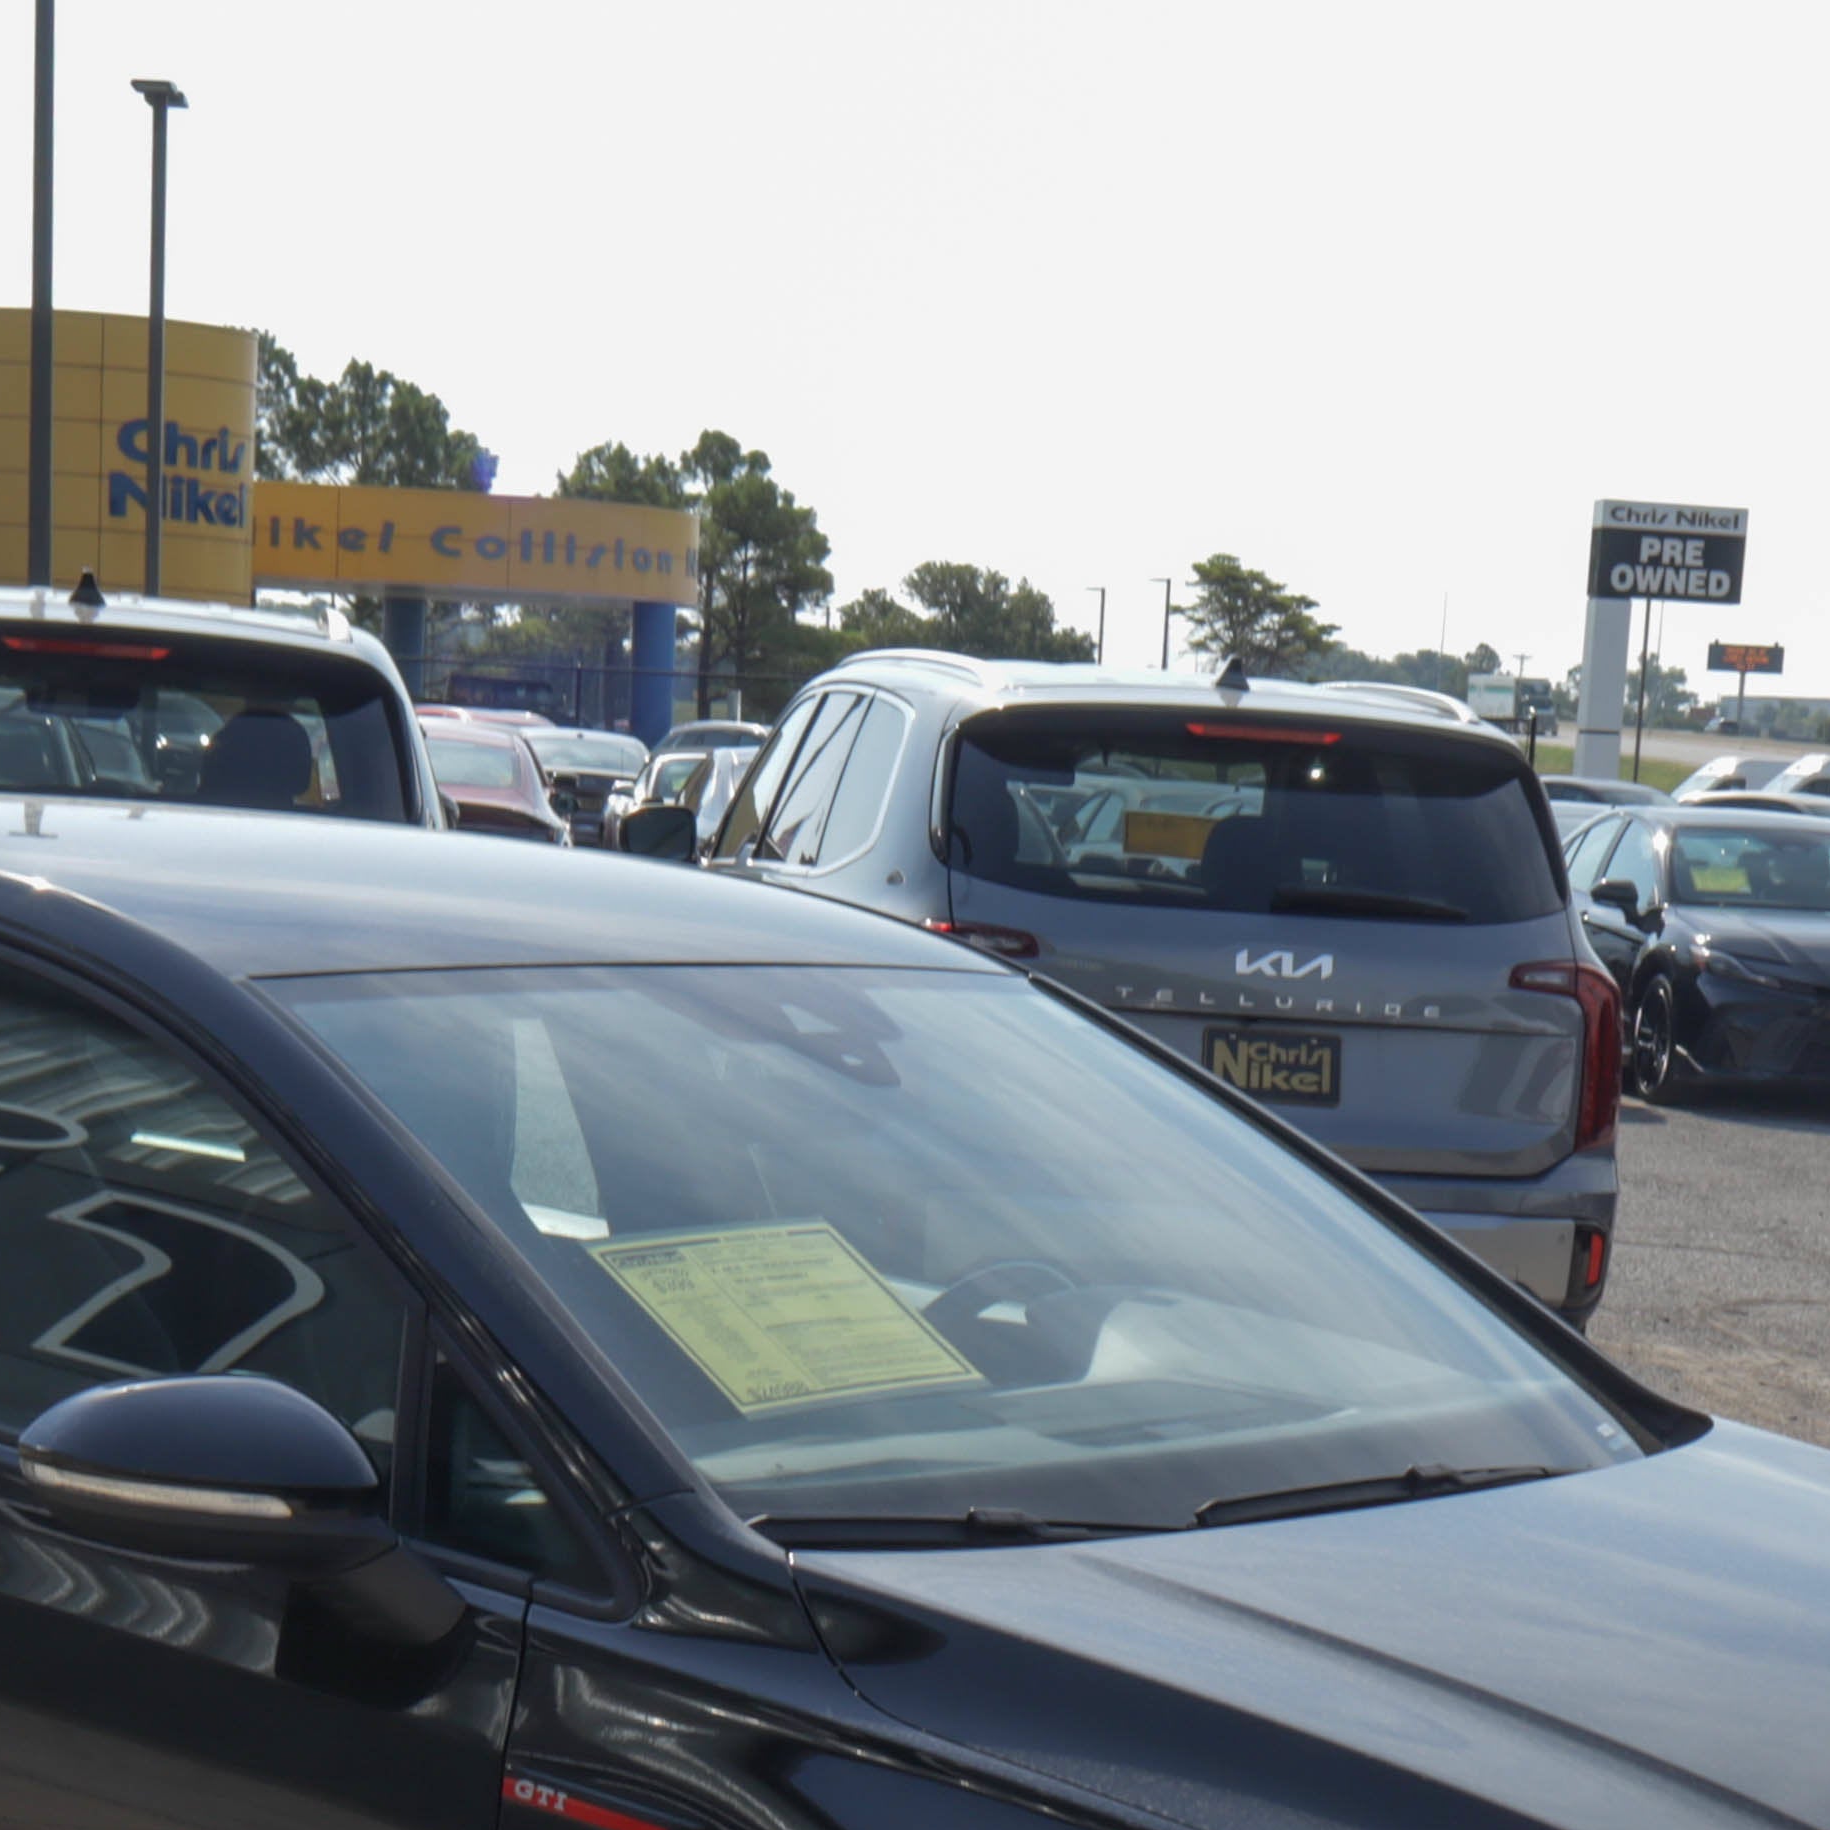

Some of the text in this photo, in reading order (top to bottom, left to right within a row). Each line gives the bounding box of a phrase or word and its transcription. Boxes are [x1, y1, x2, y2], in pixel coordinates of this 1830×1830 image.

[117, 418, 245, 473] Chris
[109, 472, 245, 528] Nikel
[1610, 505, 1740, 531] Chris Nikel
[253, 515, 395, 555] ikel
[430, 524, 672, 576] Collision
[1640, 535, 1706, 568] PRE
[1610, 564, 1731, 598] OWNED
[1116, 985, 1440, 1019] TELLURIDE
[1212, 1038, 1332, 1095] Nikel
[1248, 1042, 1323, 1067] Chris
[515, 1780, 567, 1810] GTI
